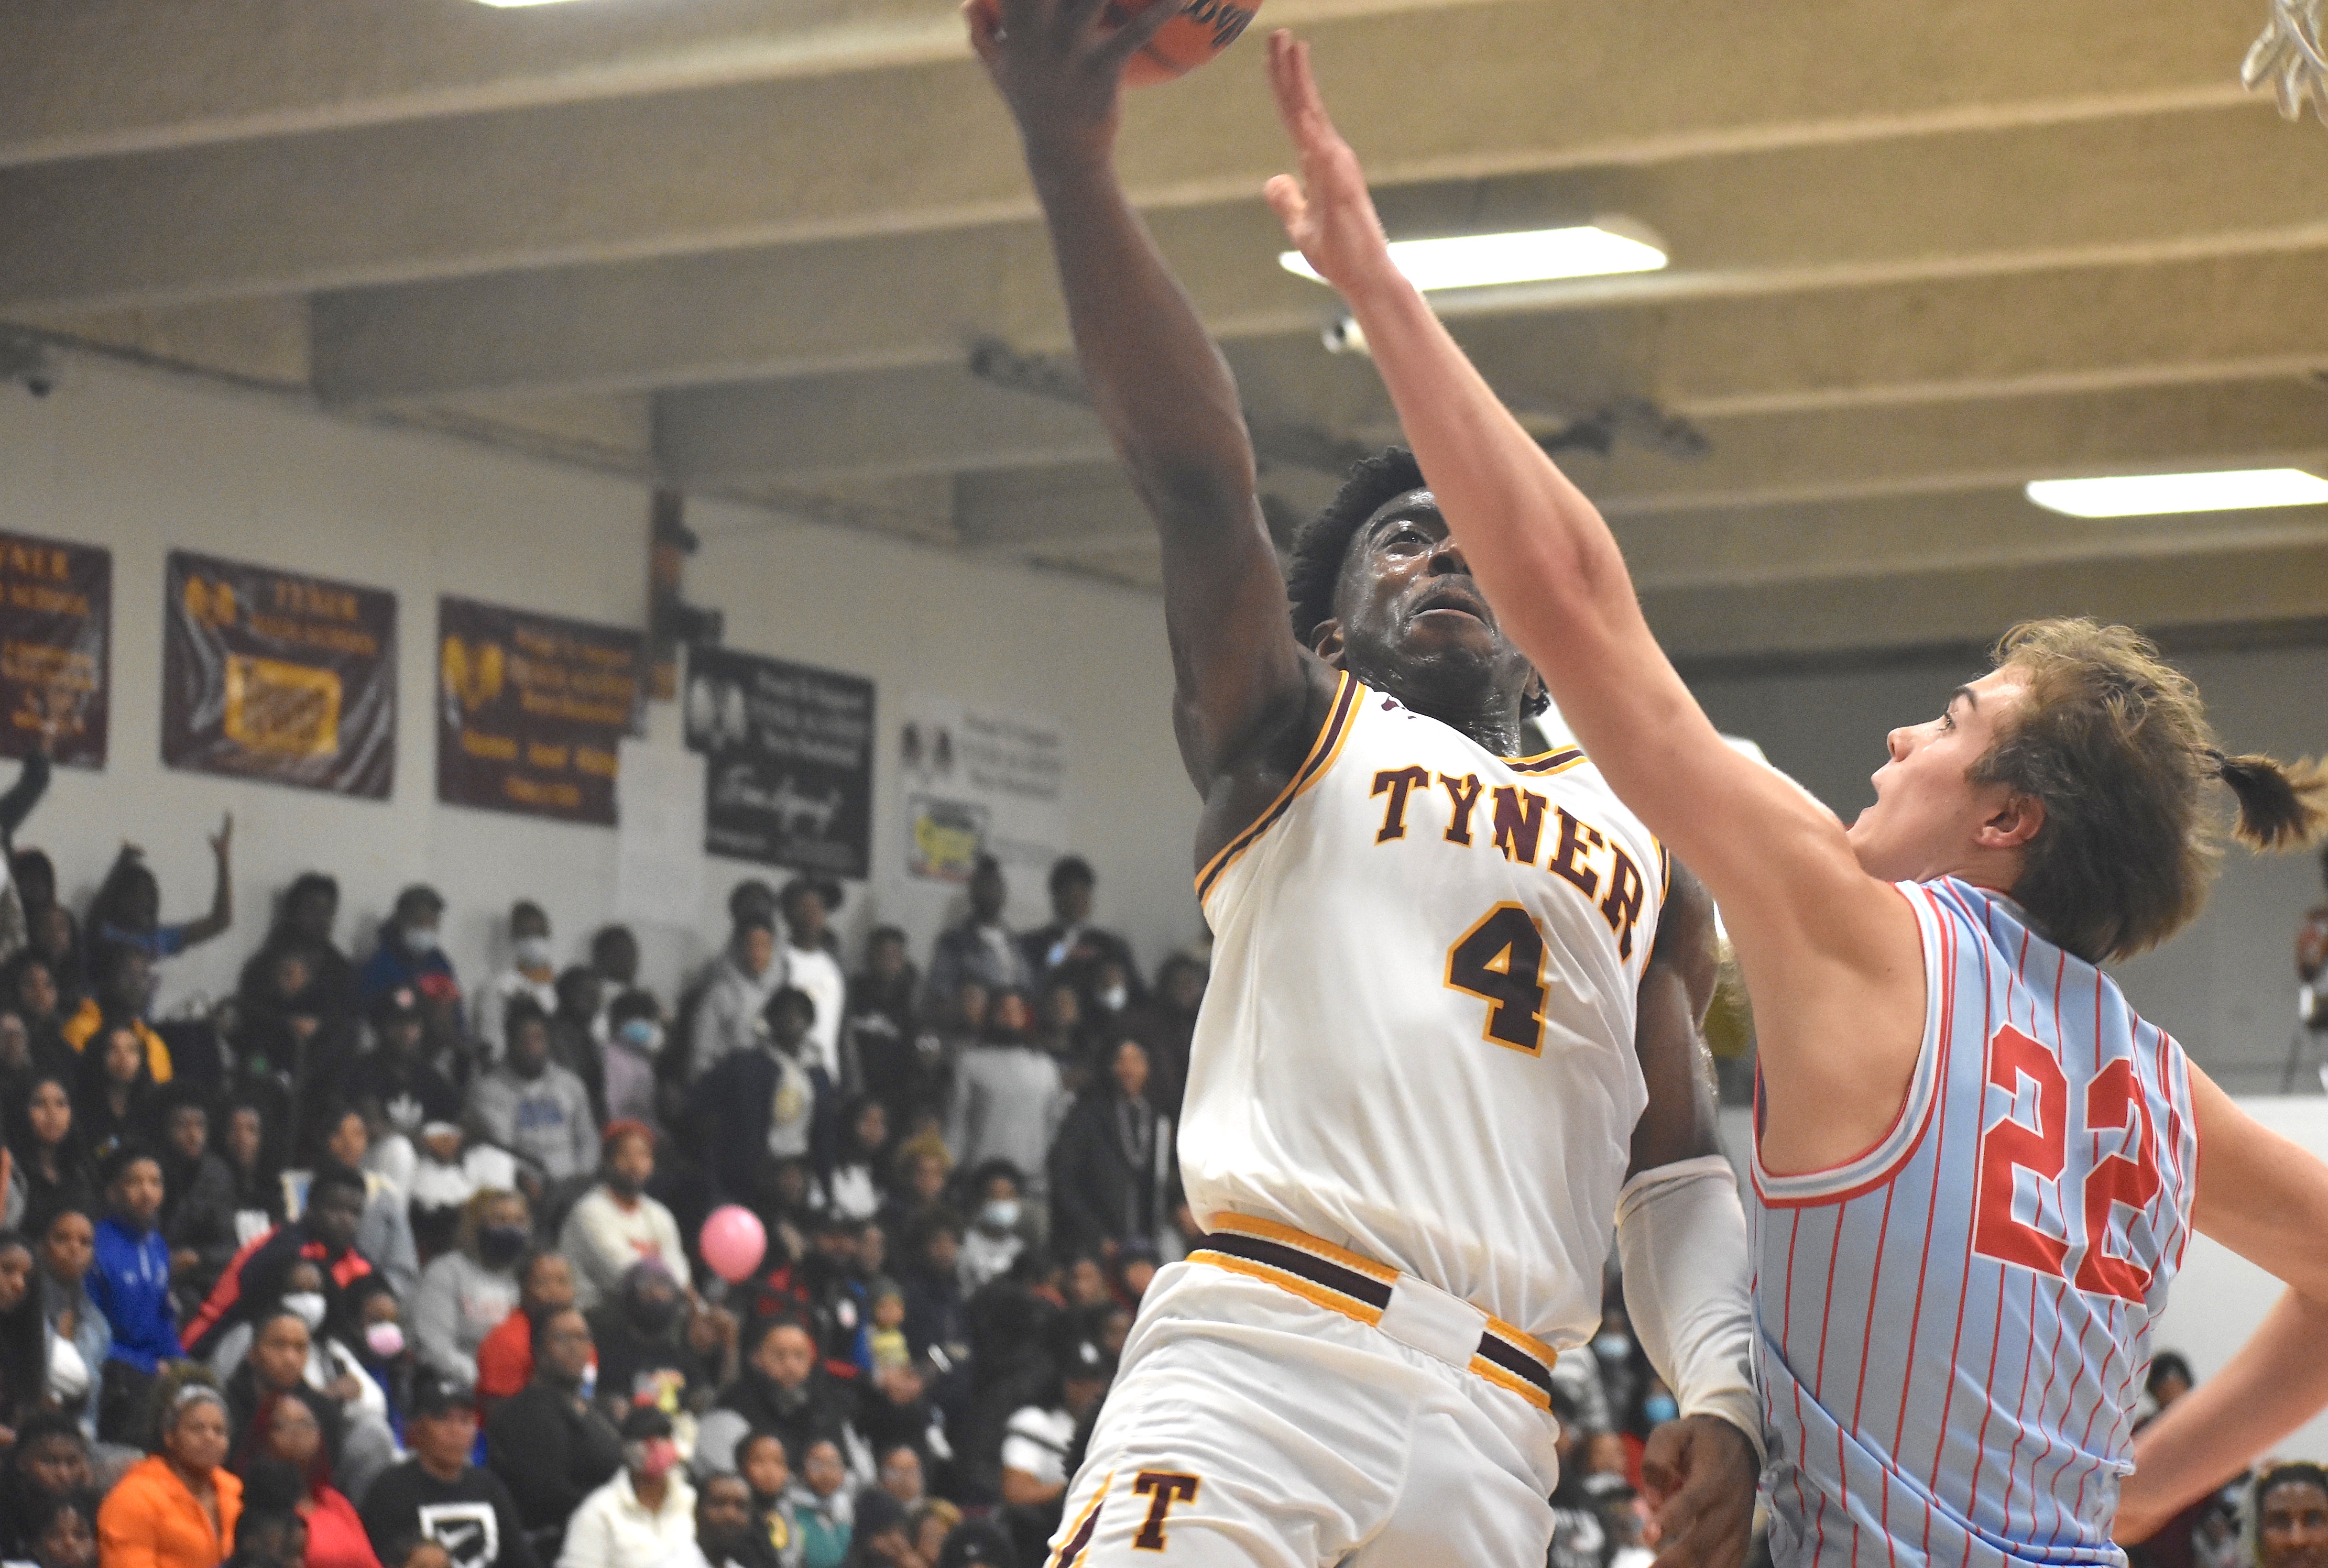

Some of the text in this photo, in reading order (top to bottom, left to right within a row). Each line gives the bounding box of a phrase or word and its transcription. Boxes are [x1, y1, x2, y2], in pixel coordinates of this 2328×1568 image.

[1369, 764, 1645, 966] TYNER
[1443, 900, 1551, 1058] 4
[1971, 1019, 2163, 1308] 22
[1132, 1469, 1201, 1552] T
